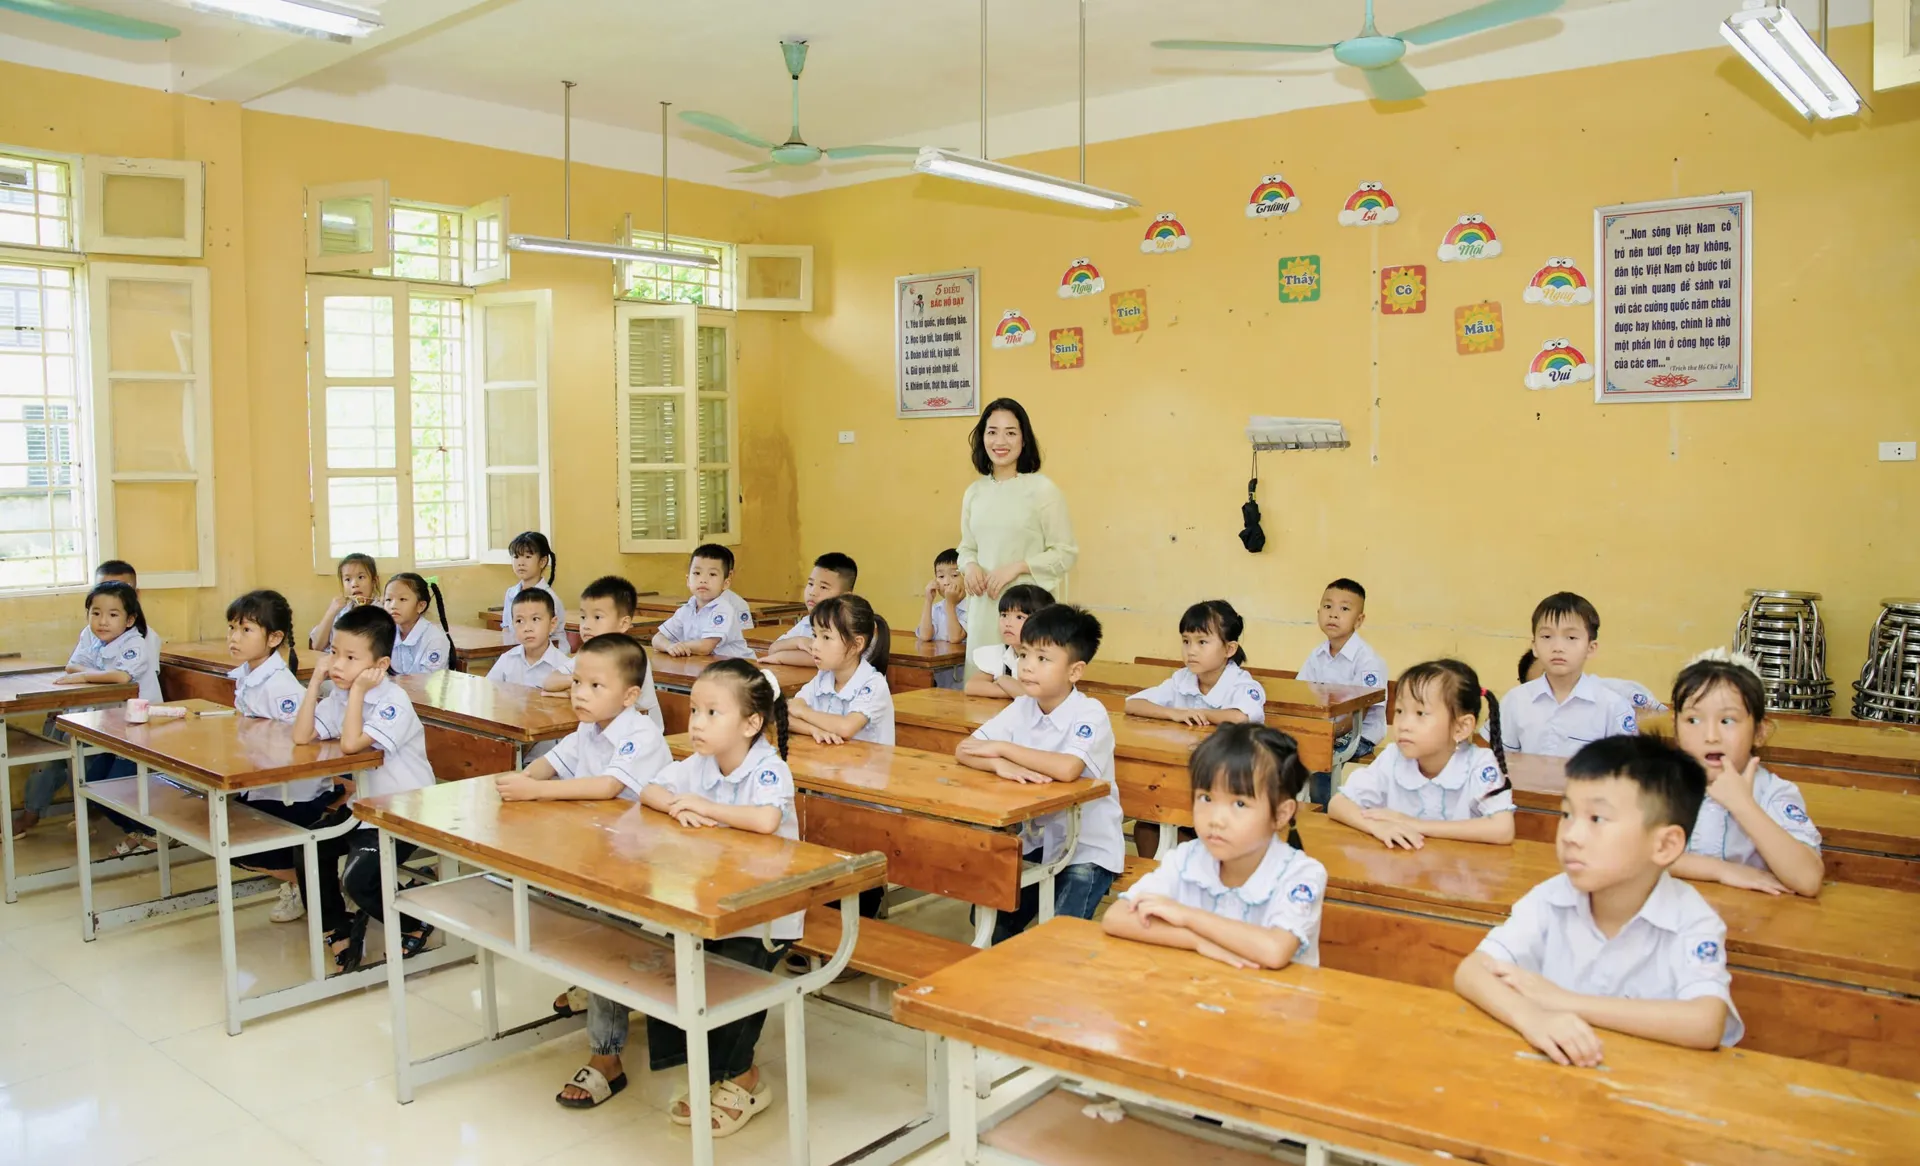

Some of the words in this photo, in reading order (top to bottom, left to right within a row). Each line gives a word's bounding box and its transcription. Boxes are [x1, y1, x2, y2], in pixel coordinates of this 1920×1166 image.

[1256, 202, 1290, 214] Trường
[1361, 210, 1378, 221] Là
[1652, 226, 1670, 238] sông
[1676, 223, 1691, 237] Việt
[1697, 223, 1715, 234] Nam
[1721, 220, 1731, 232] có
[1614, 247, 1625, 259] trở
[1629, 247, 1643, 258] nên
[1647, 245, 1662, 256] tươi
[1667, 244, 1681, 257] đẹp
[1685, 243, 1699, 254] hay
[1704, 240, 1731, 252] không,
[1614, 266, 1628, 277] dân
[1631, 265, 1643, 278] tộc
[1646, 264, 1661, 277] Việt
[1664, 263, 1682, 274] Nam
[1685, 261, 1695, 272] có
[1698, 260, 1717, 272] bước
[1721, 258, 1731, 269] tới
[935, 284, 942, 295] 5
[1395, 284, 1413, 295] Cô
[1614, 285, 1626, 295] đài
[1652, 283, 1675, 294] quang
[1681, 278, 1691, 292] để
[1695, 279, 1714, 290] sánh
[1719, 278, 1731, 289] vai
[930, 298, 942, 308] BÁC
[952, 297, 964, 307] DẠY
[1614, 302, 1626, 314] với
[1628, 302, 1642, 313] các
[1644, 300, 1668, 313] cường
[1670, 298, 1689, 312] quốc
[1691, 299, 1708, 310] năm
[1711, 297, 1731, 308] châu
[1117, 306, 1140, 317] Tích
[1465, 321, 1494, 335] Mẫu
[1614, 322, 1633, 334] được
[1635, 321, 1649, 332] hay
[1652, 319, 1678, 331] không,
[1680, 317, 1702, 329] chính
[1705, 316, 1713, 328] là
[1716, 315, 1731, 327] nhờ
[1055, 344, 1077, 353] Sinh
[1614, 340, 1629, 352] một
[1632, 337, 1650, 351] phần
[1654, 338, 1666, 349] lớn
[1669, 336, 1674, 348] ở
[1677, 337, 1696, 348] công
[1700, 337, 1714, 349] học
[1718, 335, 1731, 349] tập
[1614, 357, 1628, 369] của
[1630, 358, 1644, 369] các
[1549, 369, 1572, 382] Vui
